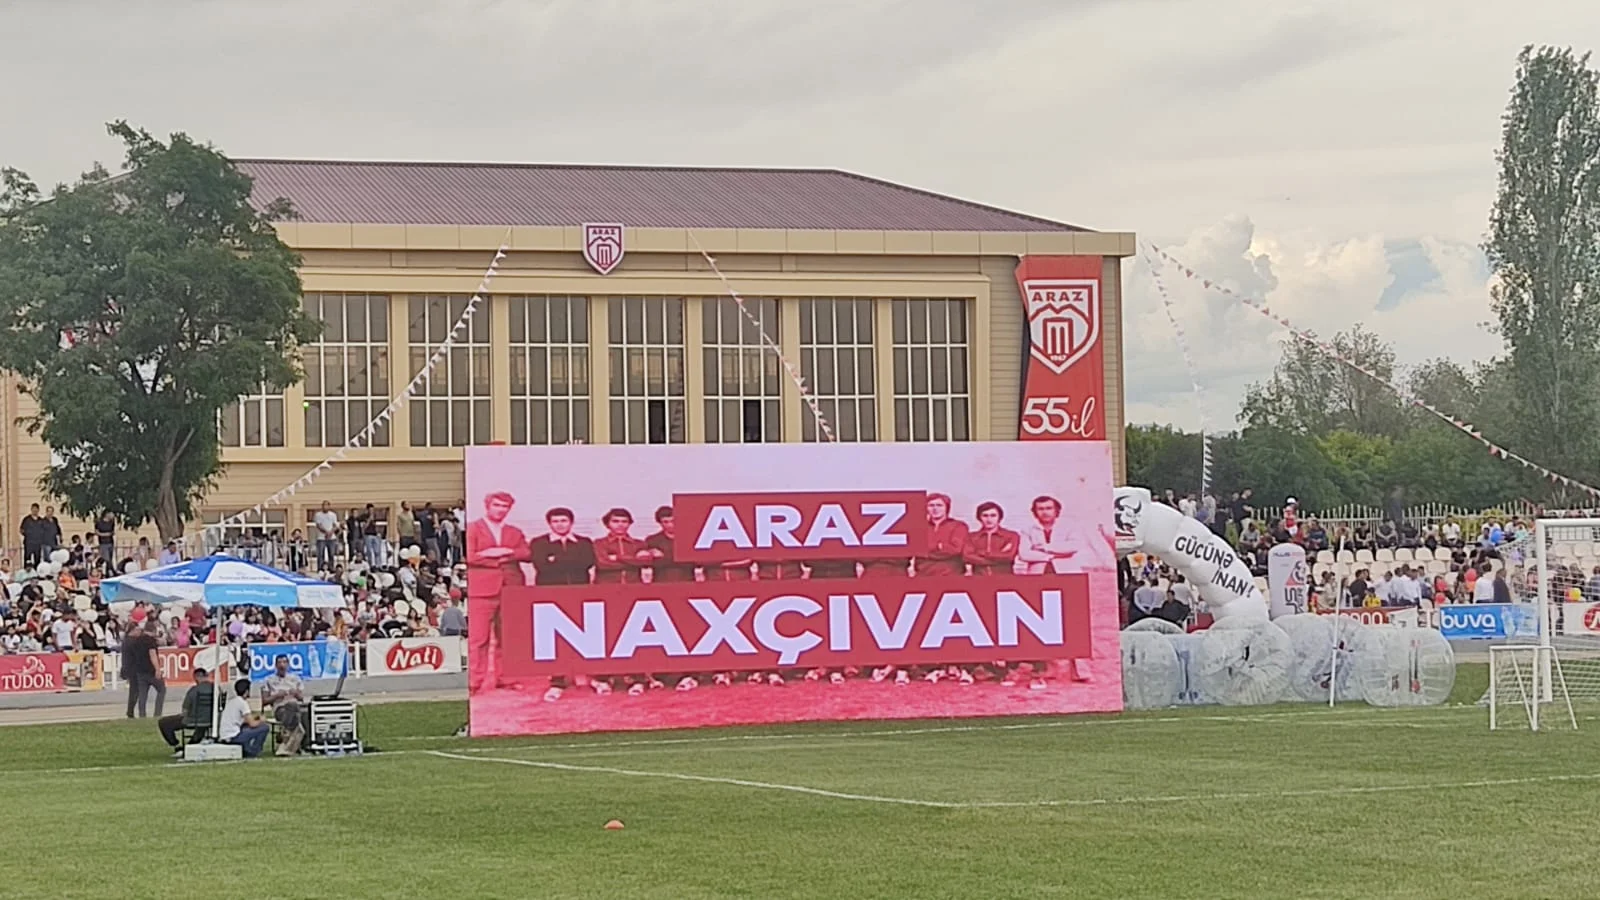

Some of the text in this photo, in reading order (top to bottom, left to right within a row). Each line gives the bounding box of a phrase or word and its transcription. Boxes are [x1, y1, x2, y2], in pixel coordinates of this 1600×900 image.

[1032, 291, 1084, 302] ARAZ
[694, 502, 908, 549] ARAZ
[532, 590, 1064, 665] NAXÇIVAN
[1441, 609, 1496, 628] buva
[251, 649, 303, 673] bua
[391, 647, 437, 668] Nati
[1, 673, 54, 690] TUDOR
